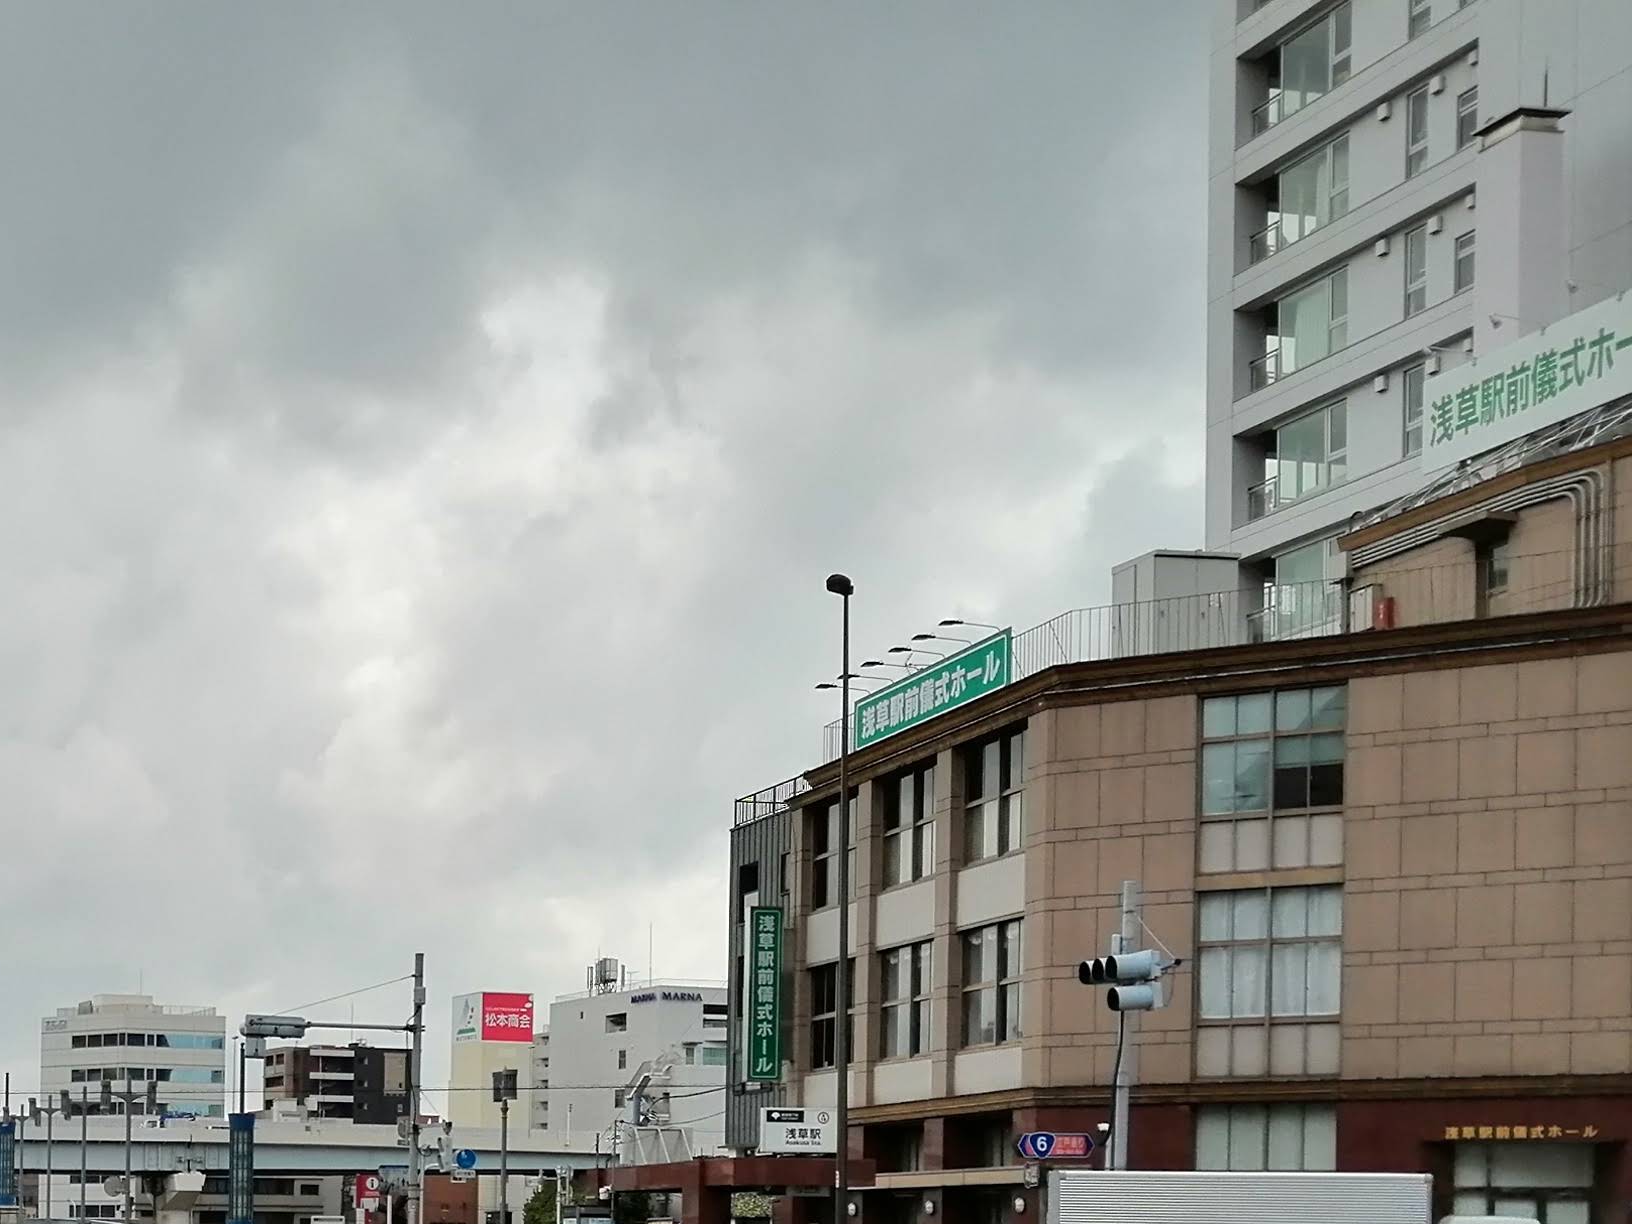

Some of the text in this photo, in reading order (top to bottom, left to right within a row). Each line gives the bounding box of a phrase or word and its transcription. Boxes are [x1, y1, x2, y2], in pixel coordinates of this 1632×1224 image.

[861, 650, 1001, 740] 浅草駅前儀式ホール
[662, 991, 704, 1002] MARNA
[755, 915, 776, 1074] 浅草駅前儀式ホール
[485, 1013, 531, 1029] 松本商会
[785, 1127, 822, 1140] 浅草駅
[1036, 1136, 1048, 1152] 6
